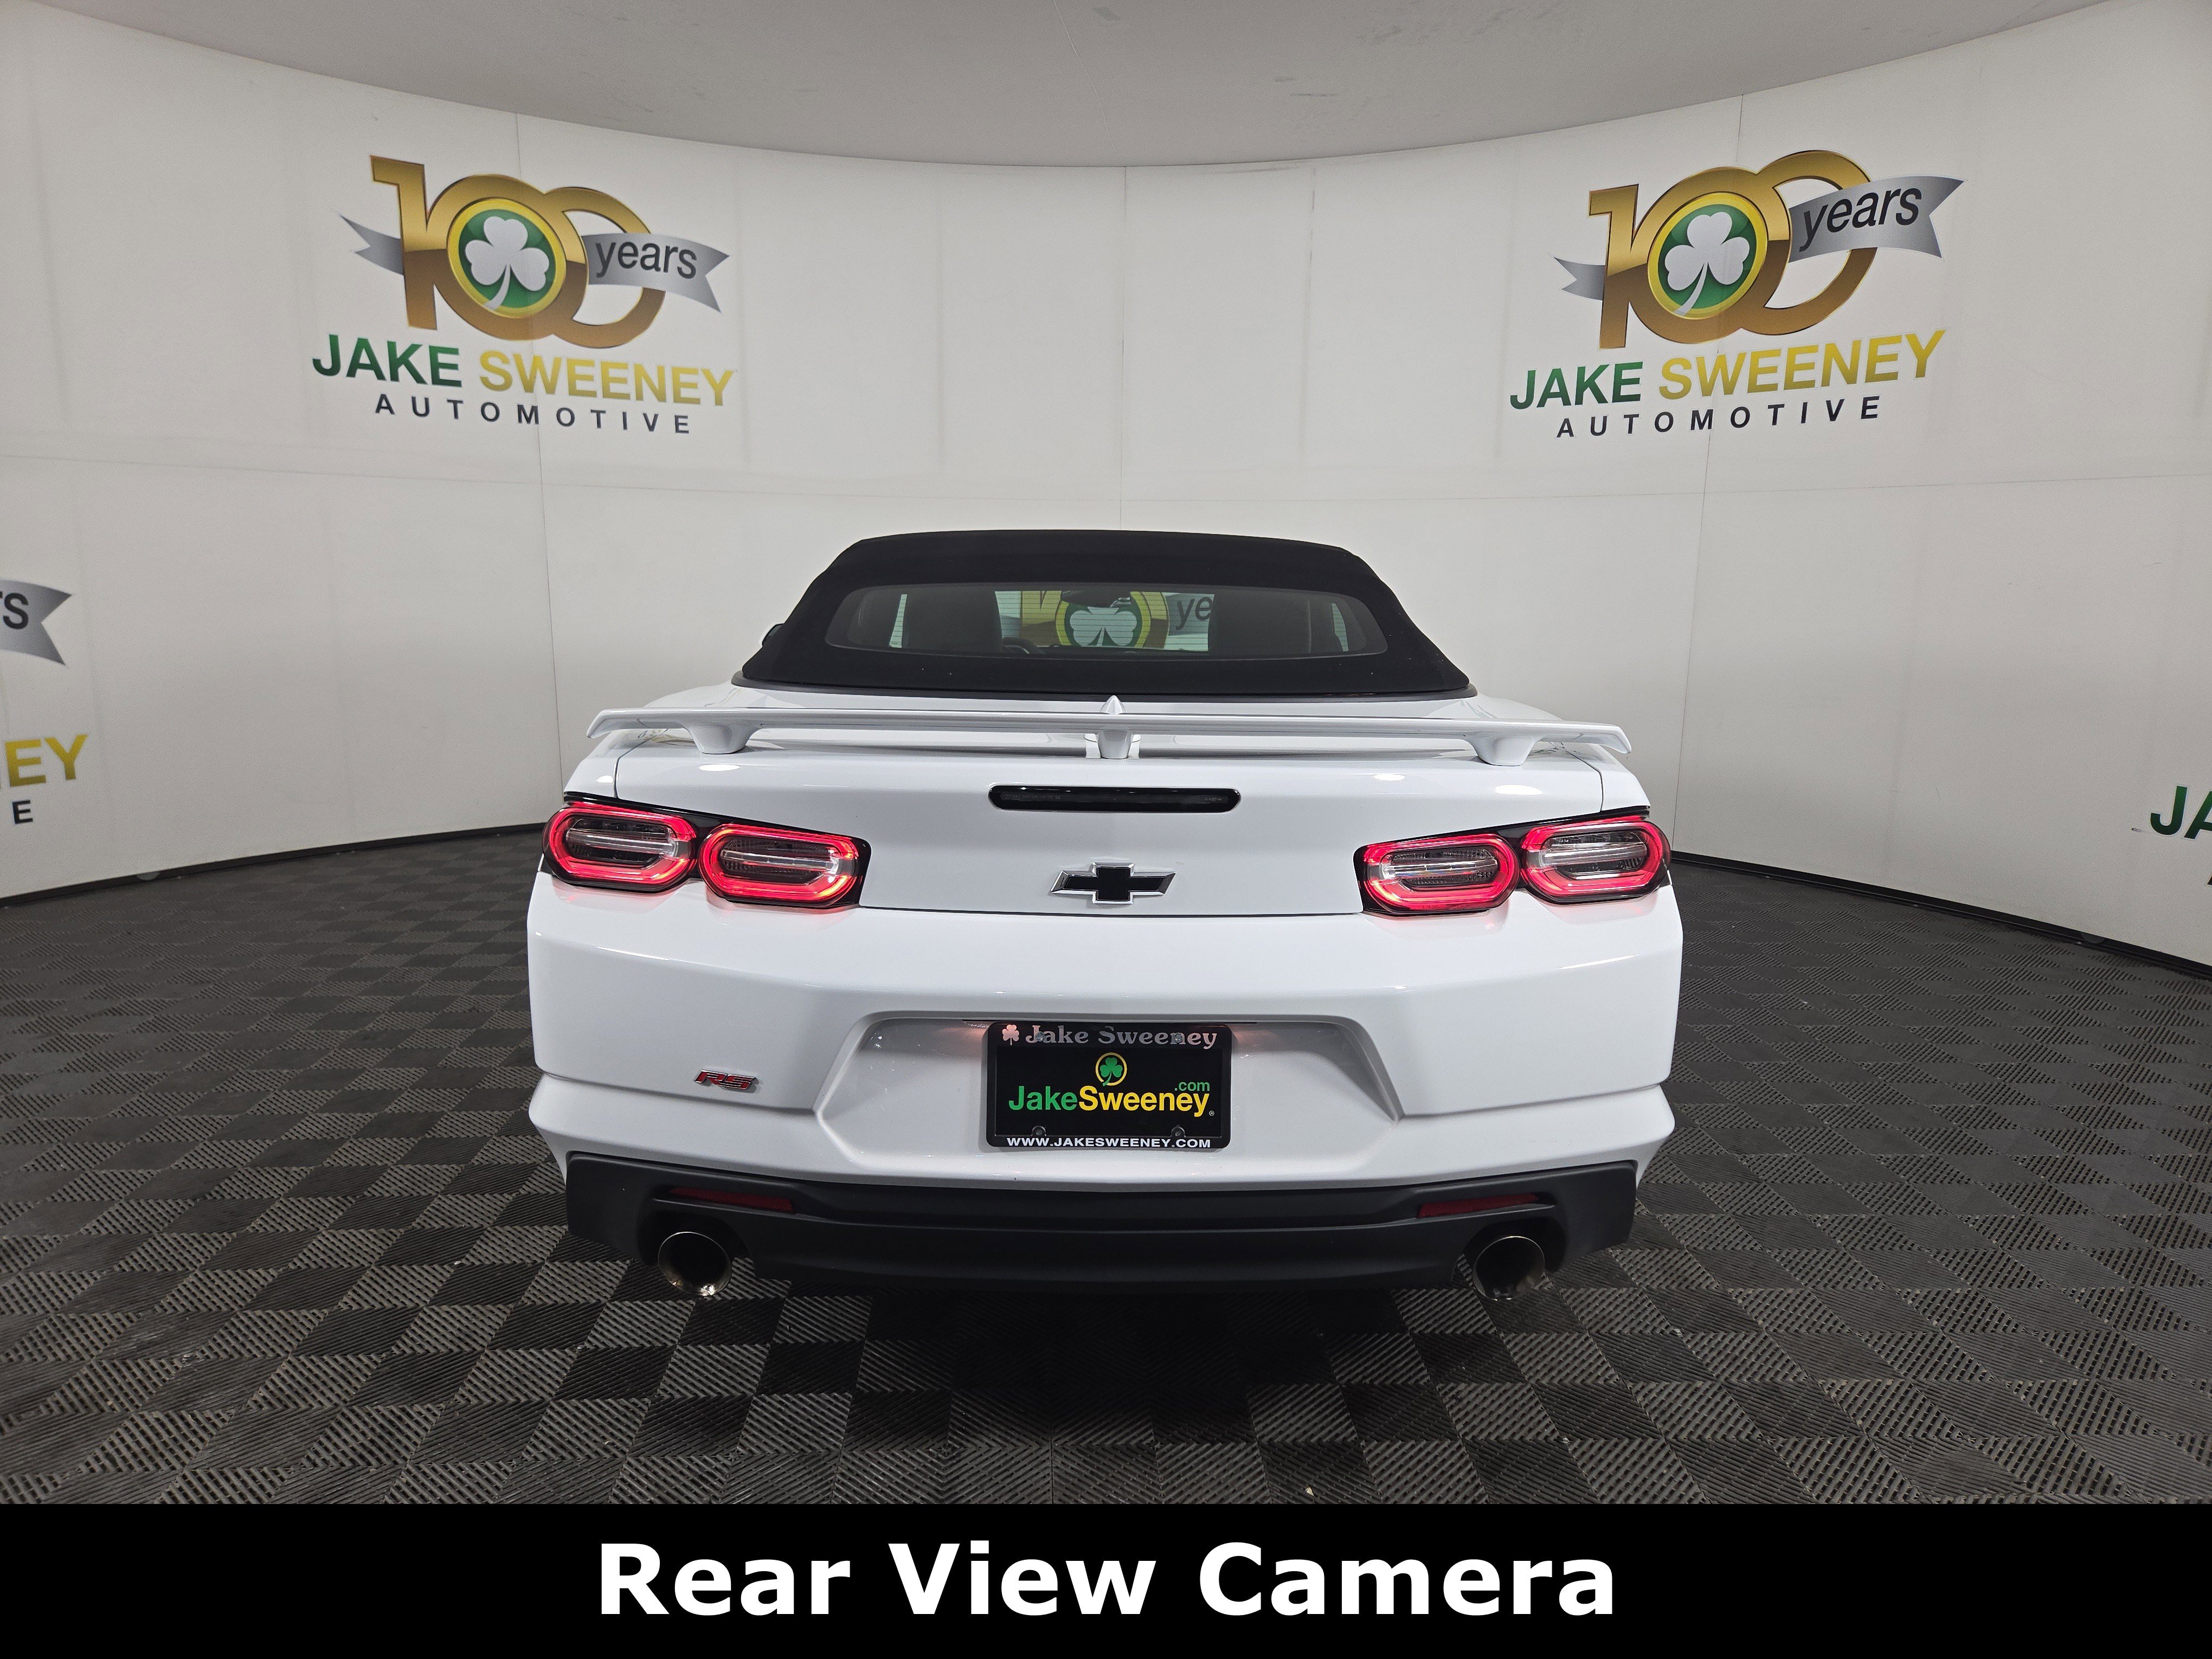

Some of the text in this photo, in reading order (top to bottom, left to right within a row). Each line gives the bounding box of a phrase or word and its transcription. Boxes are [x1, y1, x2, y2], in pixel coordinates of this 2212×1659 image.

[370, 155, 697, 349] 100 years
[1589, 150, 1922, 349] 100 years
[312, 333, 734, 406] JAKE SWEENEY
[1510, 329, 1946, 410] JAKE SWEENEY
[375, 394, 690, 434] AUTOMOTIVE
[1557, 396, 1880, 438] AUTOMOTIVE
[1026, 1025, 1218, 1050] Jake Sweeney
[694, 1070, 756, 1090] RS
[1174, 1082, 1210, 1091] .com
[1007, 1137, 1211, 1148] WWW.JAKESWEENEY.COM
